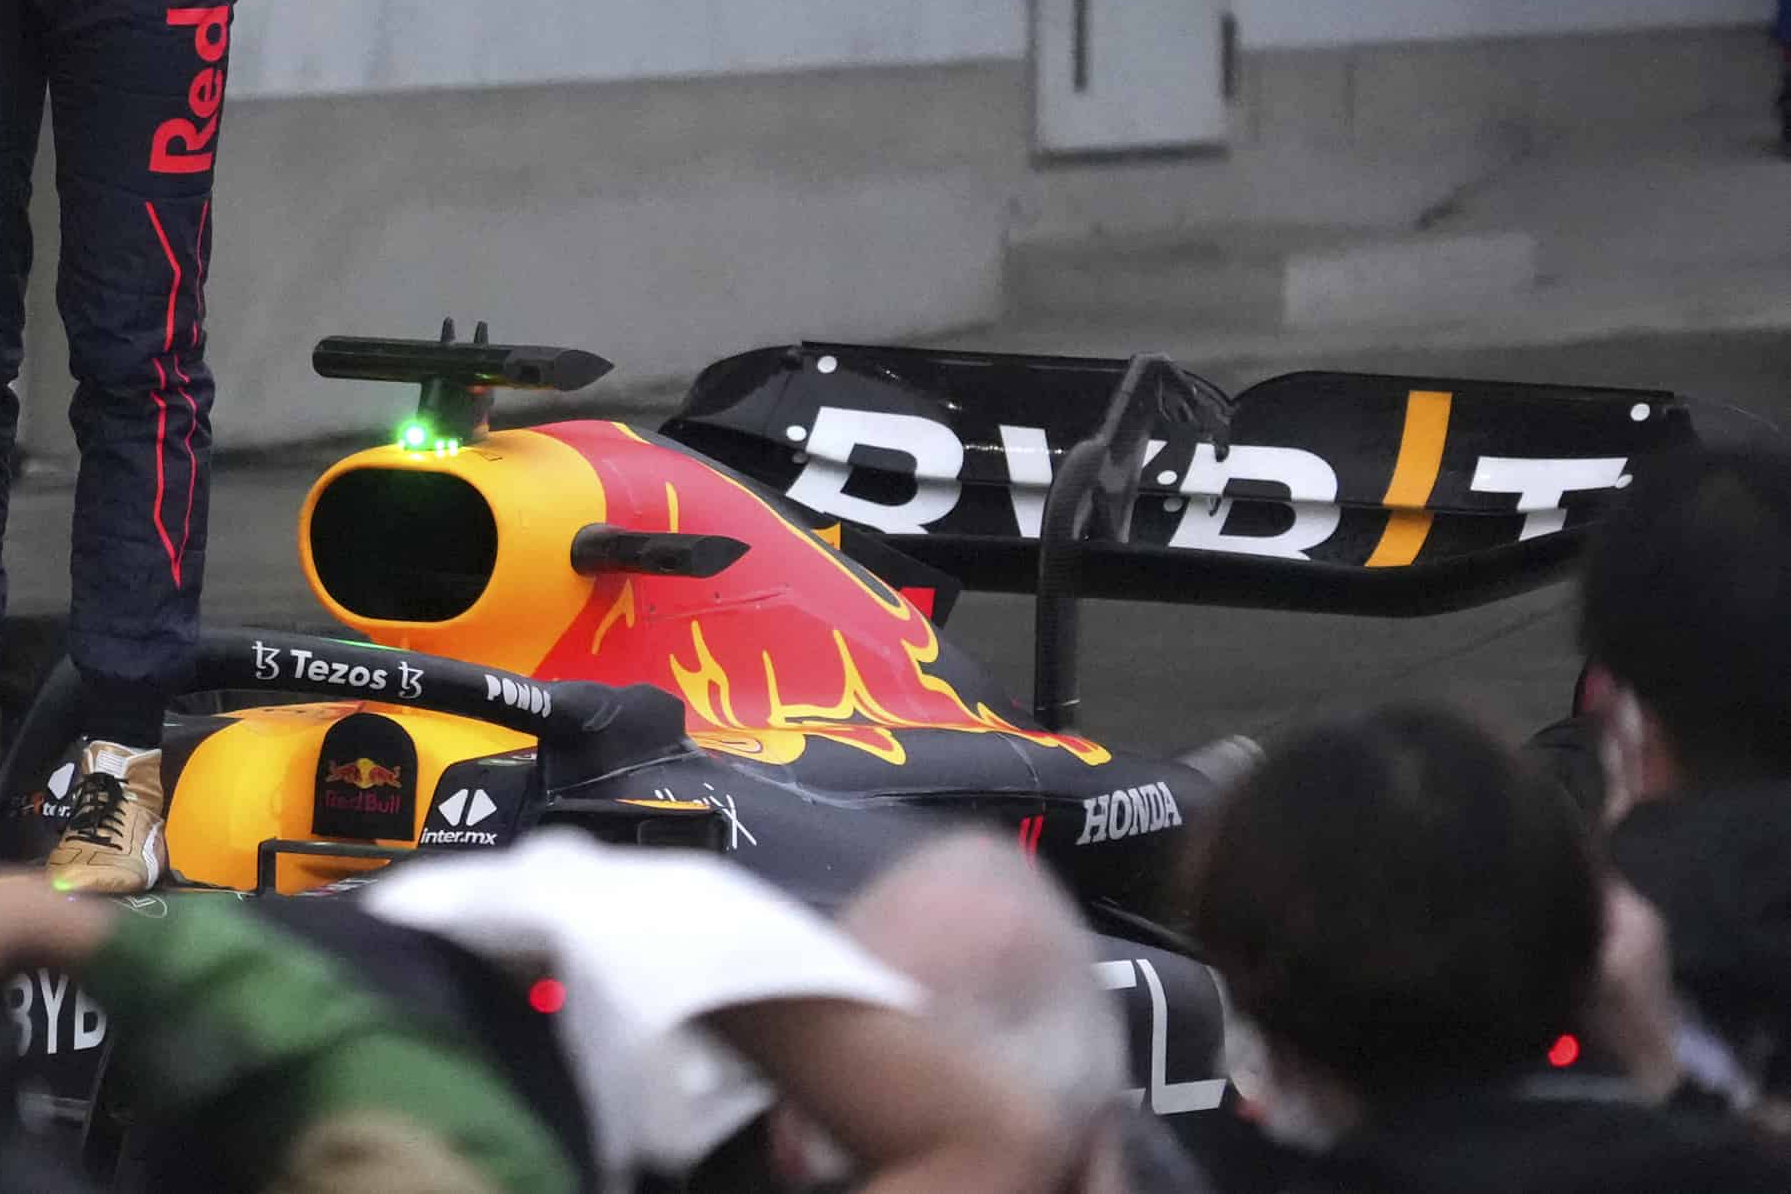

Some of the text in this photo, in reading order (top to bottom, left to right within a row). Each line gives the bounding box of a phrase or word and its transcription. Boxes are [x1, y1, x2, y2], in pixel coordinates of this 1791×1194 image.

[148, 5, 228, 174] Red
[289, 648, 388, 691] Tezos
[366, 791, 402, 815] Bull
[1076, 781, 1184, 847] HONDA
[420, 827, 498, 846] inter.mx
